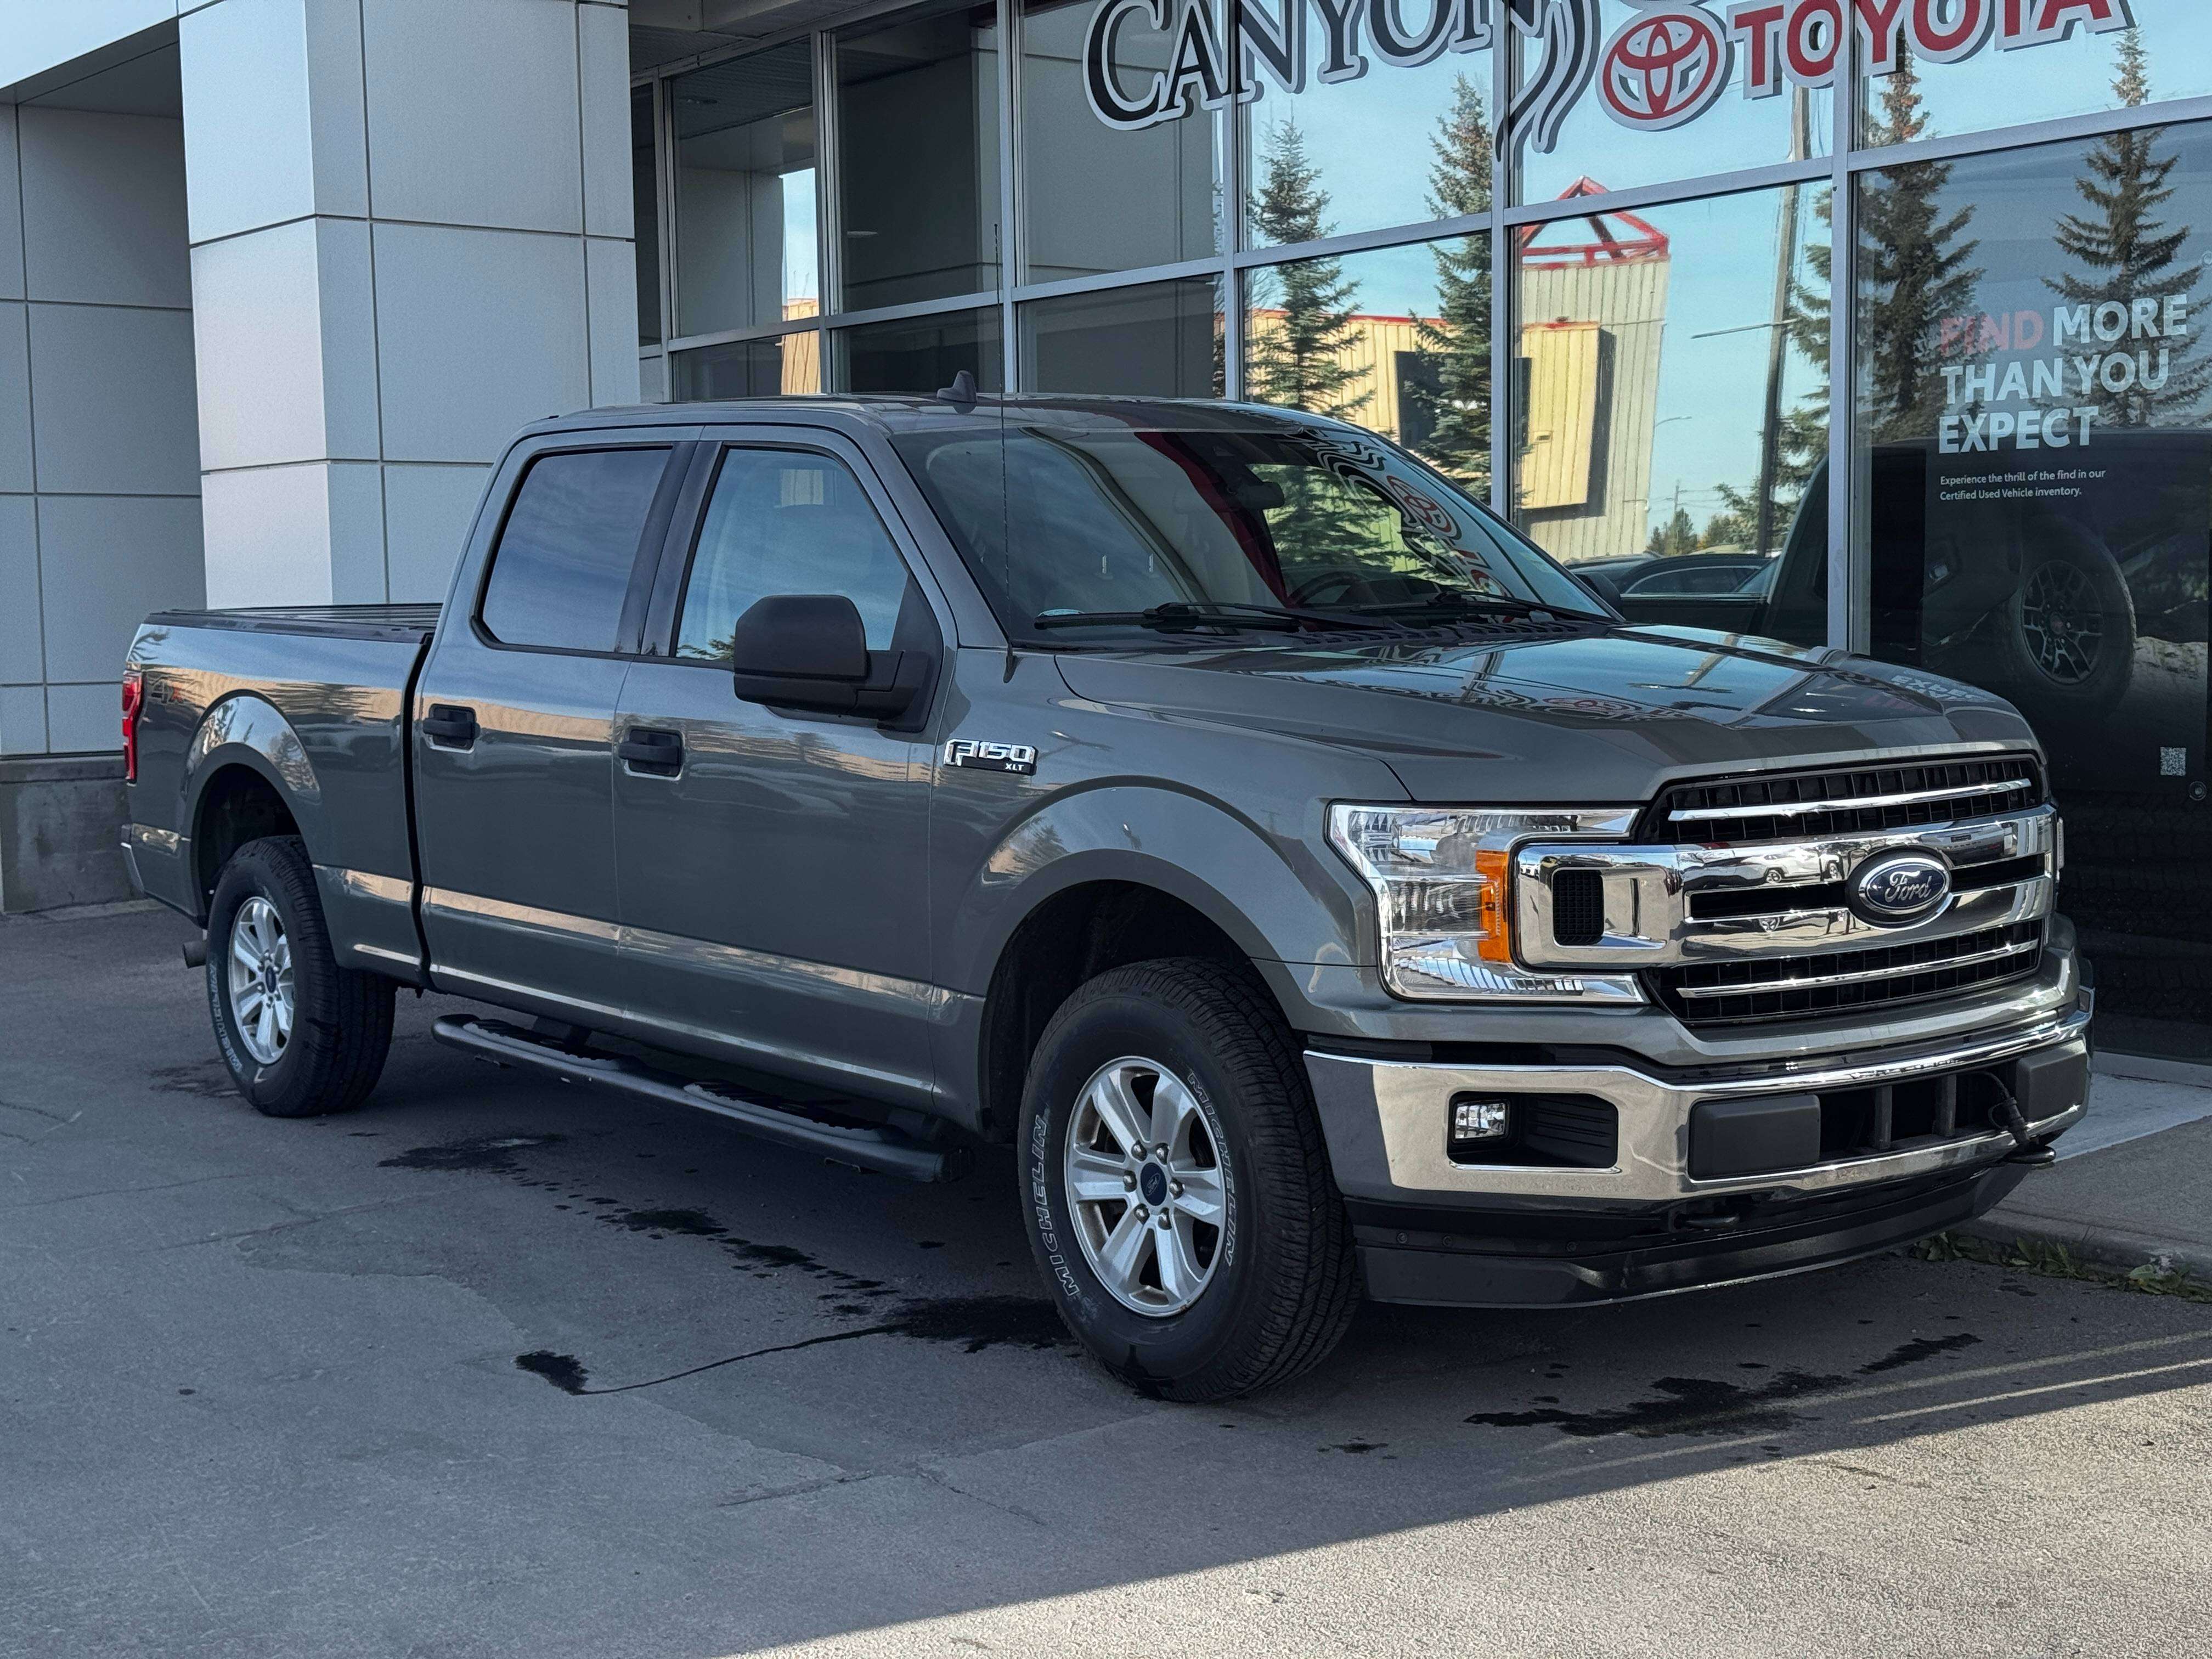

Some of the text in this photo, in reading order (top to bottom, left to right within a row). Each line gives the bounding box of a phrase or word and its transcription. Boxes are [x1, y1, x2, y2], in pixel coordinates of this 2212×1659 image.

[1940, 294, 2188, 357] FIND MORE
[1940, 348, 2169, 404] THAN YOU
[1939, 405, 2100, 454] EXPECT
[1940, 469, 2107, 487] Experience the thrill of the find in our
[1940, 486, 2083, 501] Certified Used Vehicle inventory.
[1005, 763, 1025, 771] XLT
[1884, 870, 1933, 903] Ford
[1187, 1070, 1237, 1267] MICHELIN
[1032, 1114, 1080, 1297] MICHELIN
